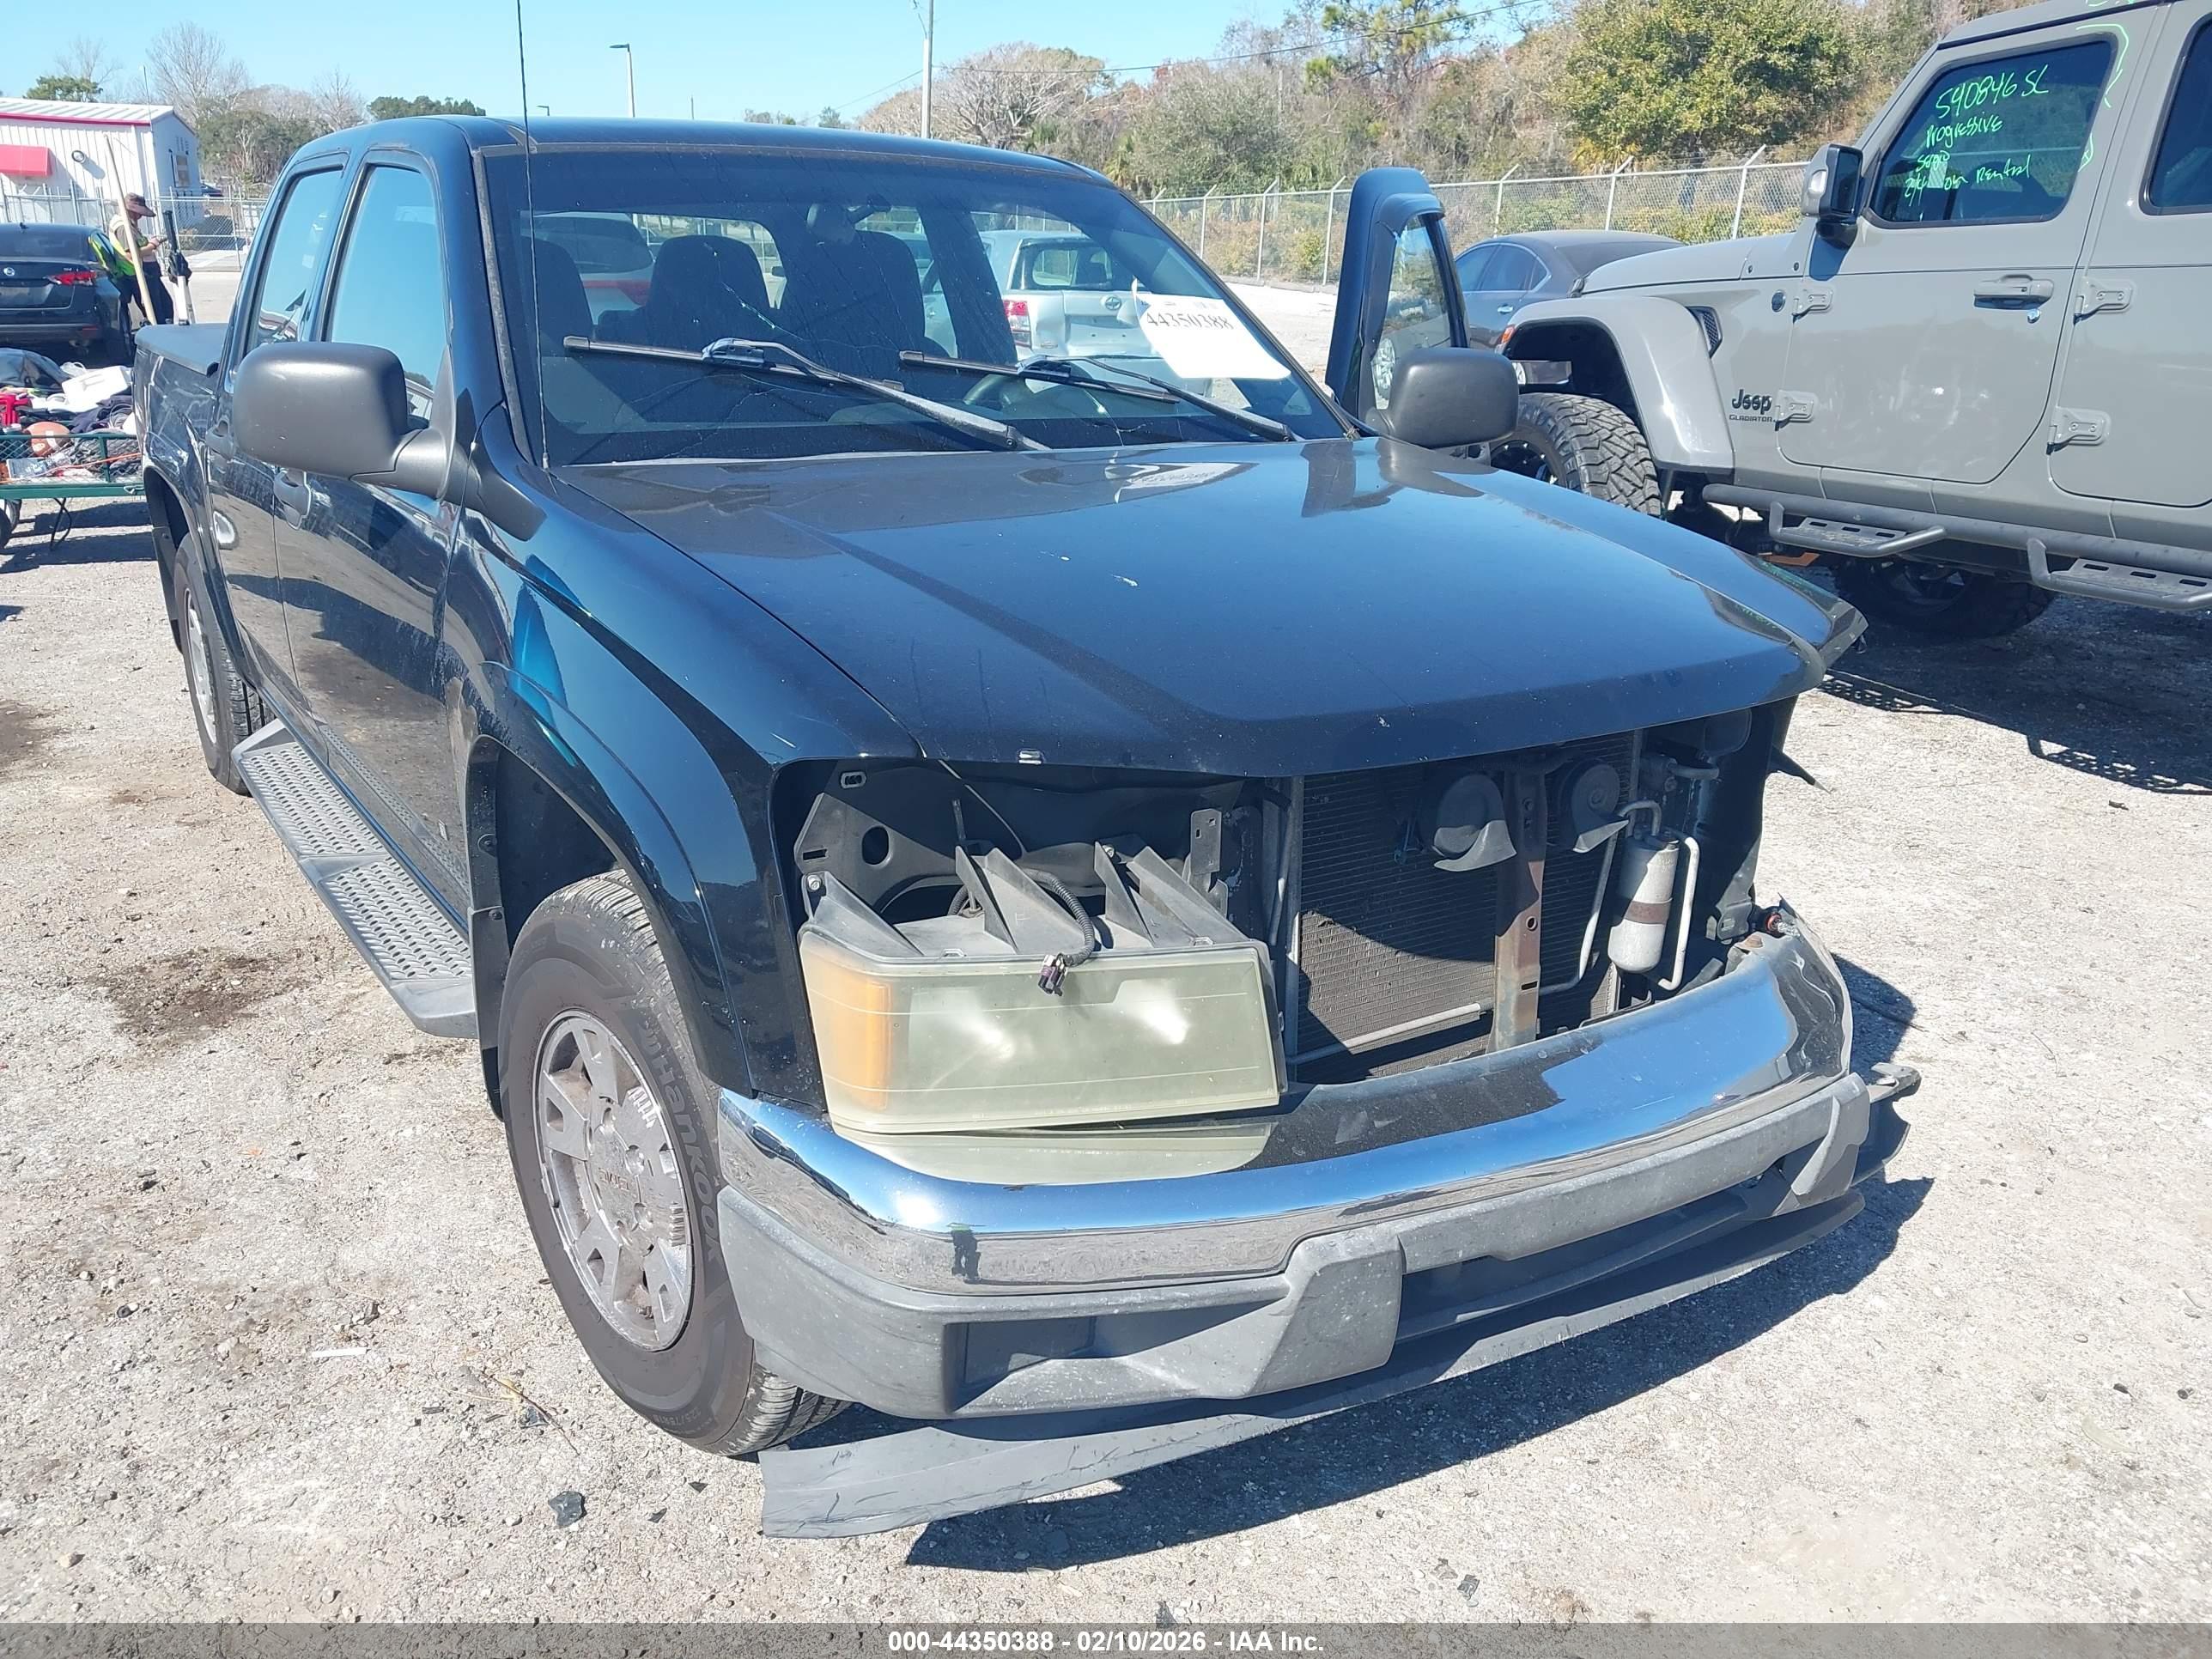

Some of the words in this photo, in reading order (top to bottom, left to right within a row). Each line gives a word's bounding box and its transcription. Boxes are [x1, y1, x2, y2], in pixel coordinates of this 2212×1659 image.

[1936, 75, 2018, 118] 540846
[1146, 312, 1235, 330] 44350388
[1731, 388, 1772, 416] Jeep
[1729, 414, 1773, 423] GLADIATOR
